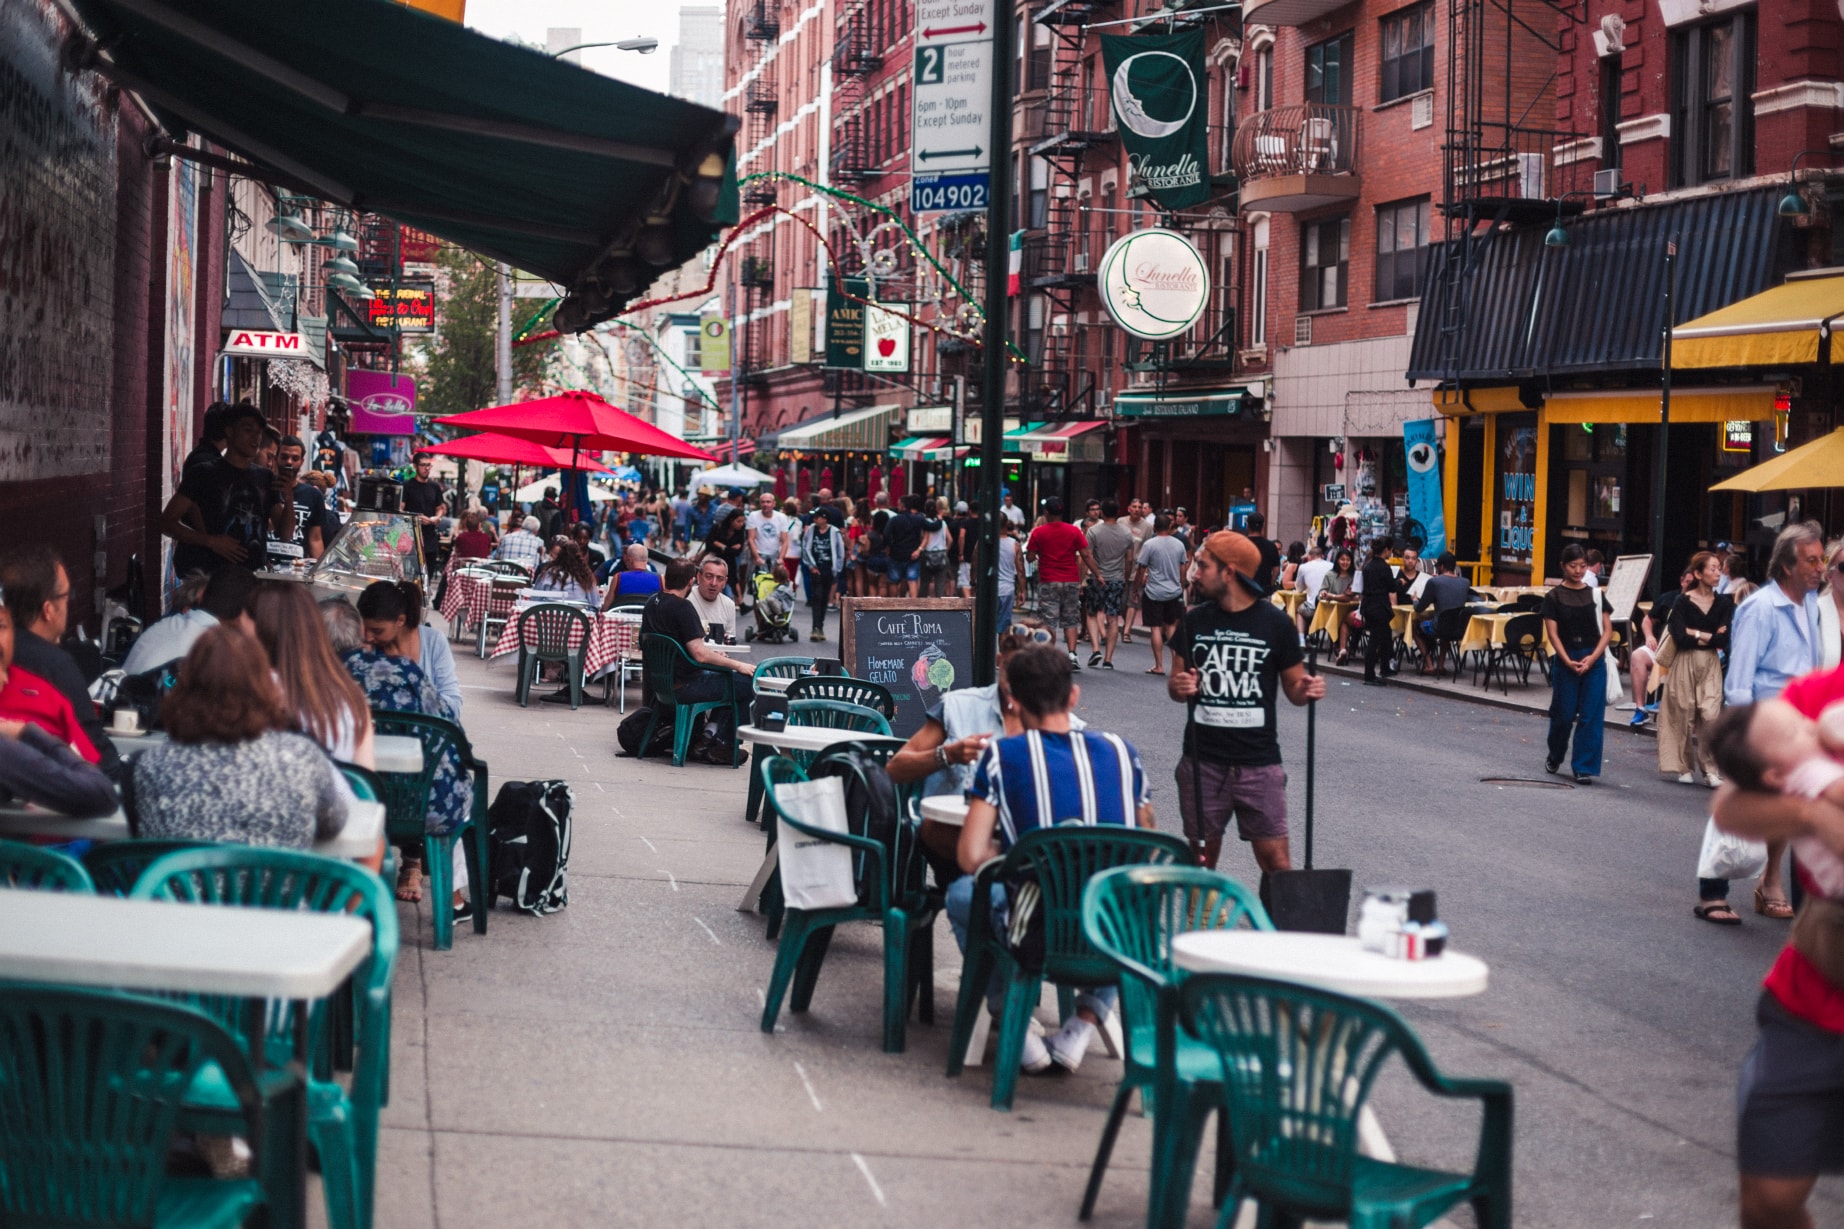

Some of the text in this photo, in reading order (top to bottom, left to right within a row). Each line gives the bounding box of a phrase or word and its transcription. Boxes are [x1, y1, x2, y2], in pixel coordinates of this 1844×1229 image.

[921, 3, 985, 20] Except Sunday
[948, 48, 965, 57] hour
[922, 48, 938, 82] 2
[947, 59, 980, 70] metered
[947, 73, 976, 85] parking
[917, 101, 937, 114] 6pm
[944, 98, 968, 111] 10pm
[917, 112, 983, 128] Except Sunday
[915, 185, 990, 209] 104902
[1136, 261, 1197, 283] Lunella
[872, 319, 904, 336] MELA
[233, 333, 299, 349] ATM
[1503, 472, 1535, 501] WIN
[1519, 505, 1527, 522] &
[912, 614, 943, 635] ROMA
[867, 656, 905, 670] HOMEMADE
[869, 670, 898, 683] GELATO
